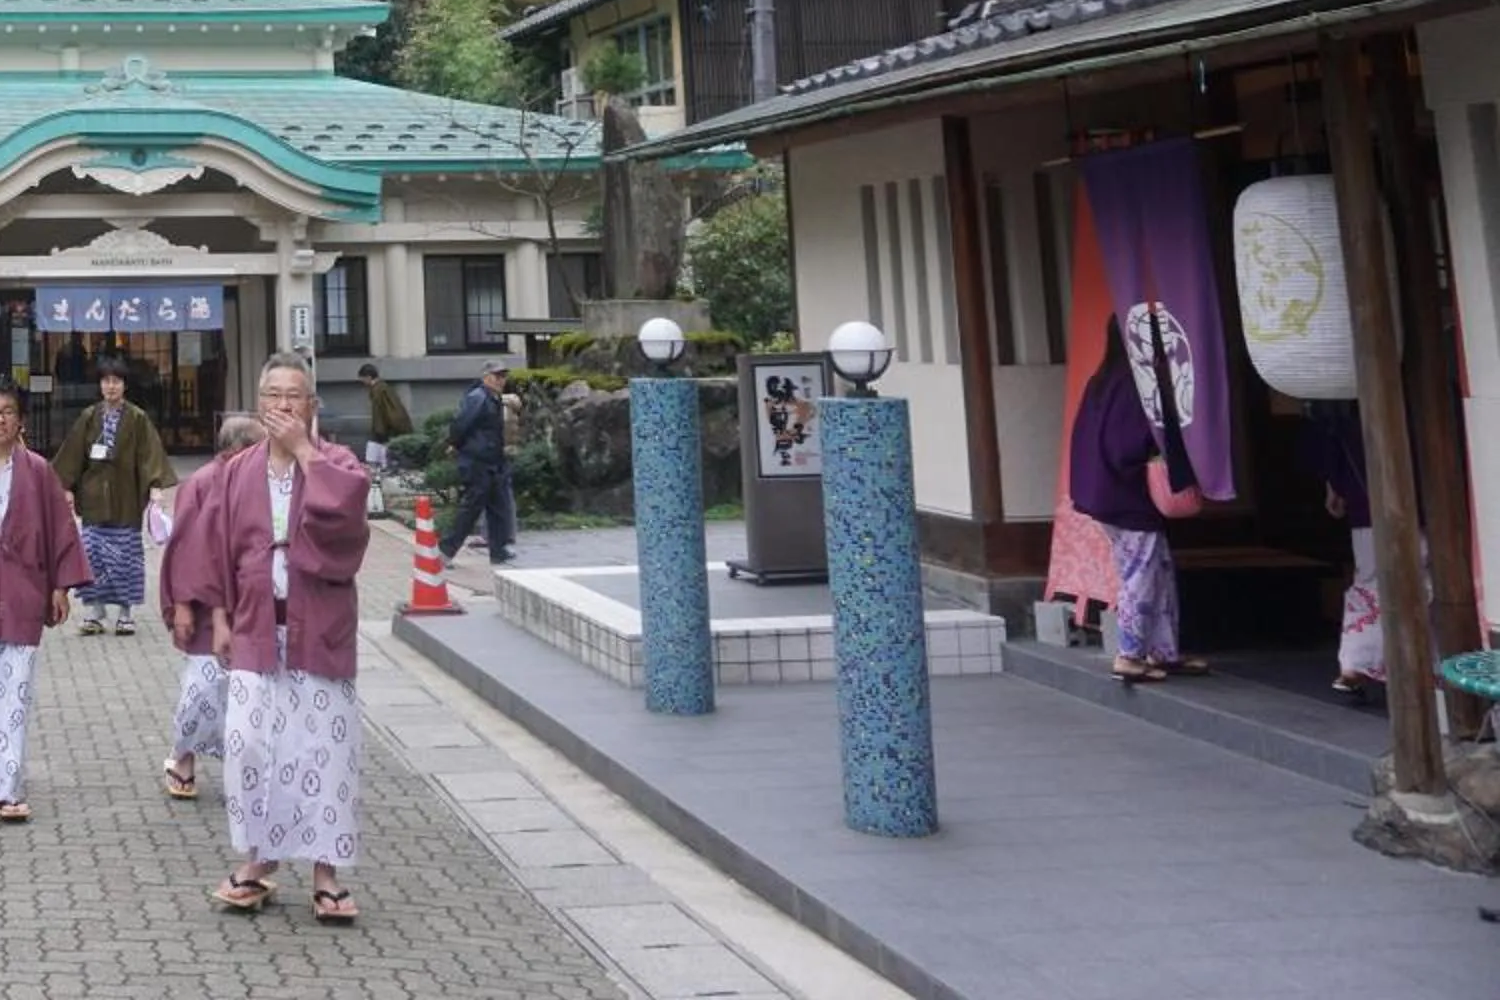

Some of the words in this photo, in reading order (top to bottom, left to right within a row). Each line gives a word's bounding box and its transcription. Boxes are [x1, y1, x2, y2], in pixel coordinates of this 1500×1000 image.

[52, 296, 211, 321] まんだら湯
